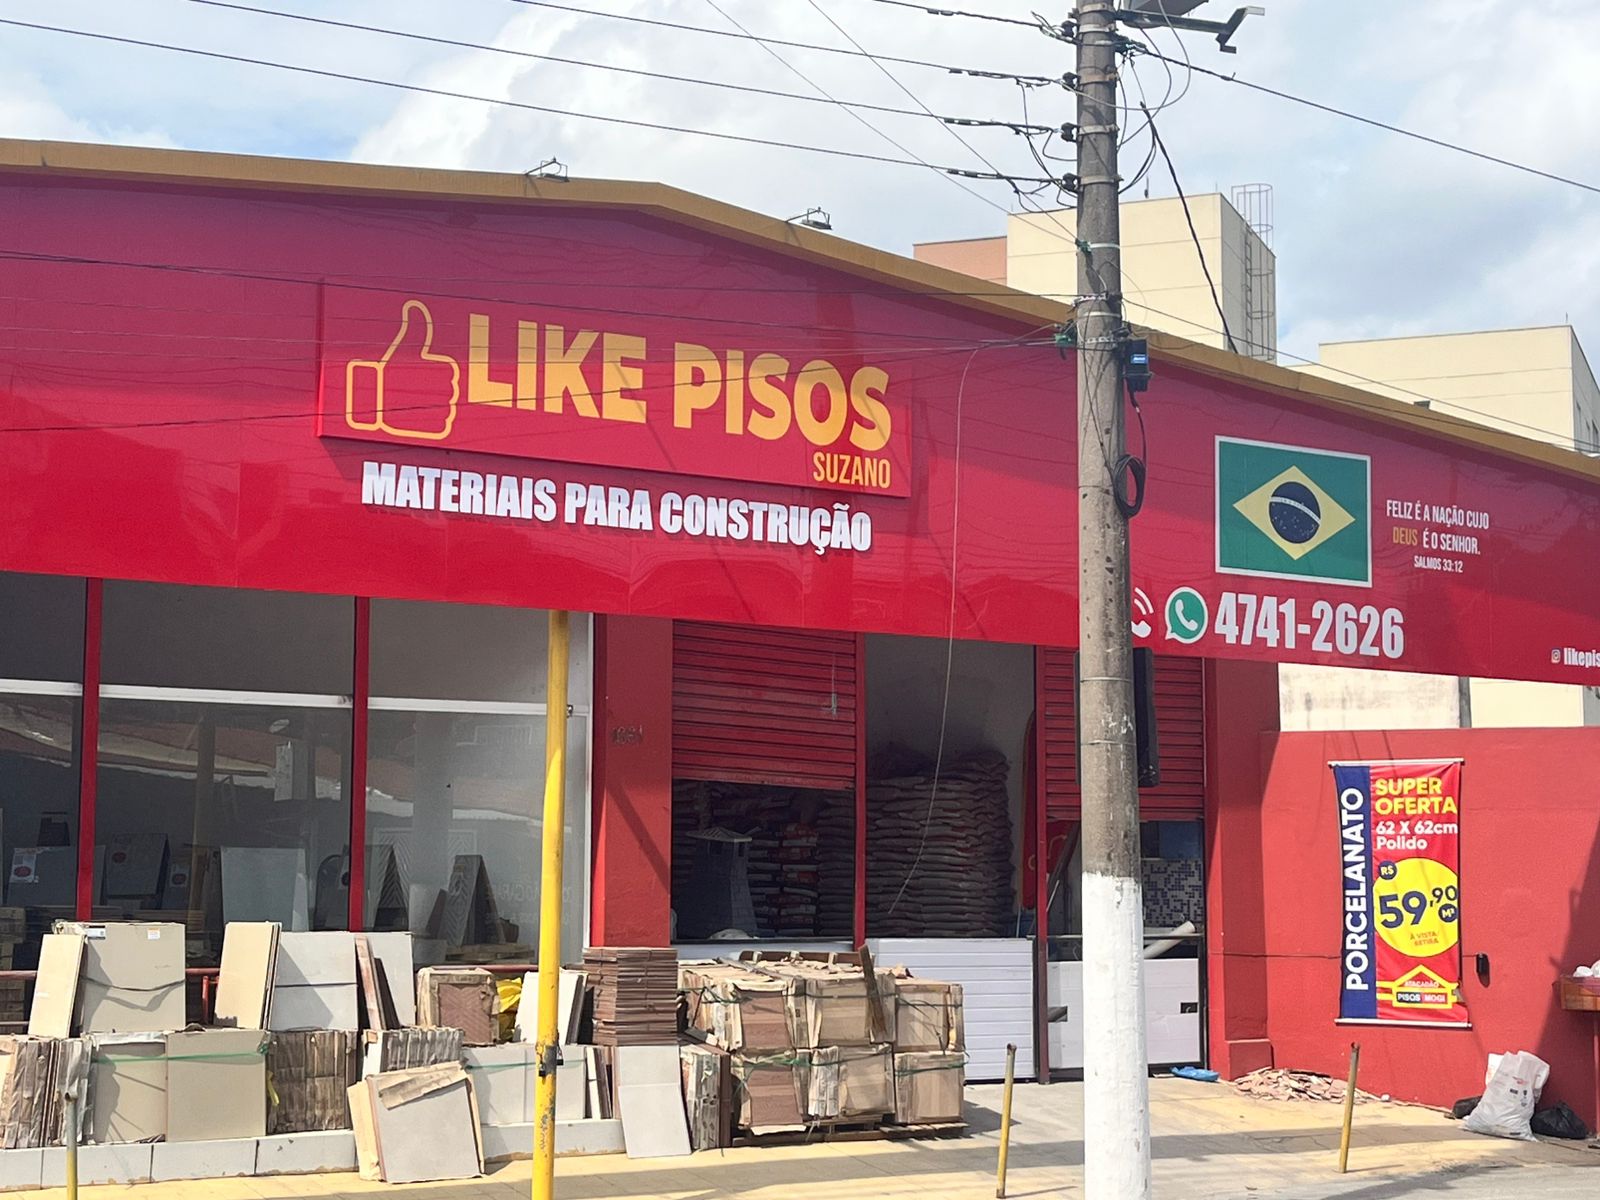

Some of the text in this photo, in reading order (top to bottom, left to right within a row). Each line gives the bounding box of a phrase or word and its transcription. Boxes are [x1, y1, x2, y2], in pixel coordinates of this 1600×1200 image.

[467, 313, 892, 452] LIKE PISOS
[813, 451, 891, 489] SUZANO
[361, 461, 872, 555] MATERIAIS PARA CONSTRUÇÃO
[1386, 499, 1490, 530] FELIZ É A NAÇÃO CUJO
[1392, 526, 1481, 555] DEUS É O SENHOR.
[1414, 555, 1464, 574] SALMOS 33:12
[1214, 591, 1405, 659] 4741-2626
[1375, 777, 1442, 796] SUPER
[1375, 796, 1458, 815] OFERTA
[1375, 820, 1458, 835] 62 X 62cm
[1376, 835, 1428, 850] Polido
[1340, 787, 1369, 991] PORCELANATO
[1397, 993, 1446, 1003] PISOS MOGI
